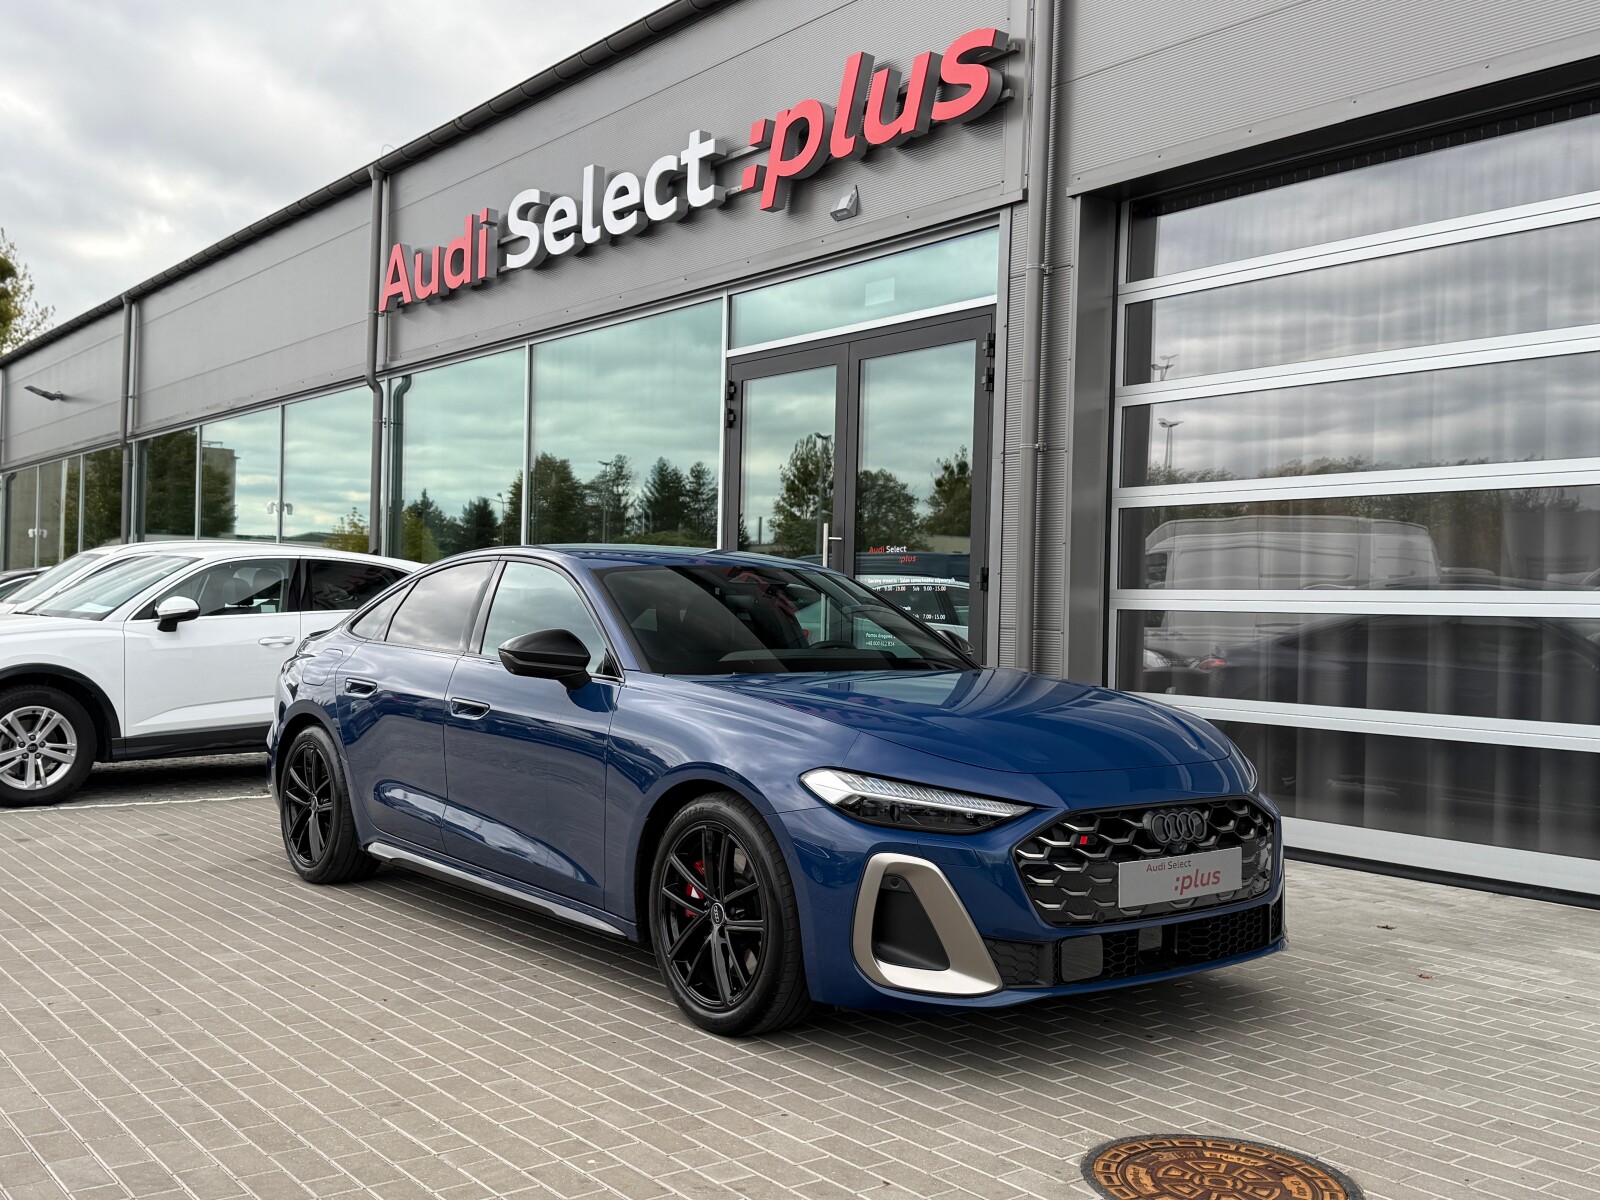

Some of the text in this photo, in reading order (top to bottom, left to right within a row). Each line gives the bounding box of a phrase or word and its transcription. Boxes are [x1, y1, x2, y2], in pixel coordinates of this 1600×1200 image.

[378, 27, 1003, 313] Audi Select :plus
[869, 545, 907, 554] Audi Select
[1146, 859, 1192, 873] Audi Select
[1174, 868, 1221, 895] :plus
